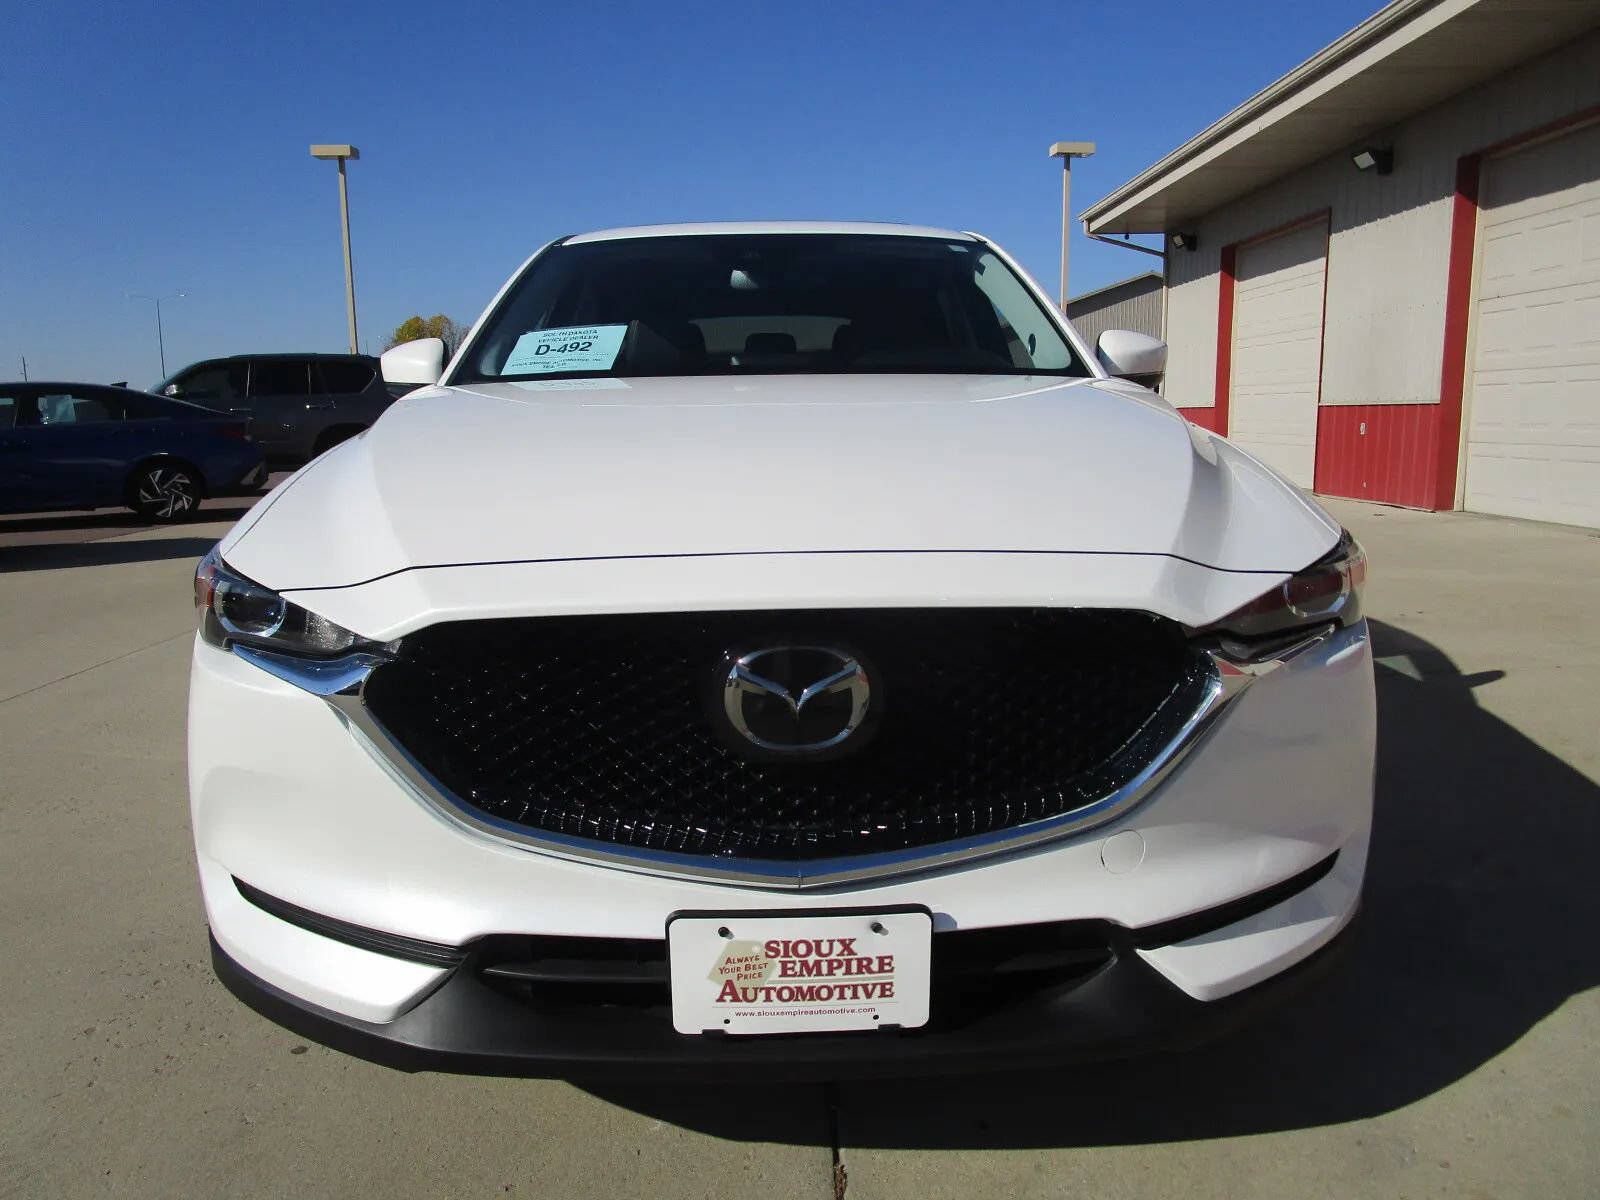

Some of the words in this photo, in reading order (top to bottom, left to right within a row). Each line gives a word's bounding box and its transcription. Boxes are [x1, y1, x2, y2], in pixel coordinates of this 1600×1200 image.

[535, 341, 593, 355] D-492
[764, 938, 858, 959] SIOUX
[725, 954, 760, 965] ALWAYS
[718, 966, 742, 975] YOUR
[744, 962, 769, 972] BEST
[778, 955, 895, 978] EMPIRE
[736, 972, 763, 981] PRICE
[715, 979, 895, 1003] AUTOMOTIVE
[734, 1006, 876, 1018] www.siouxempireautomotive.com
